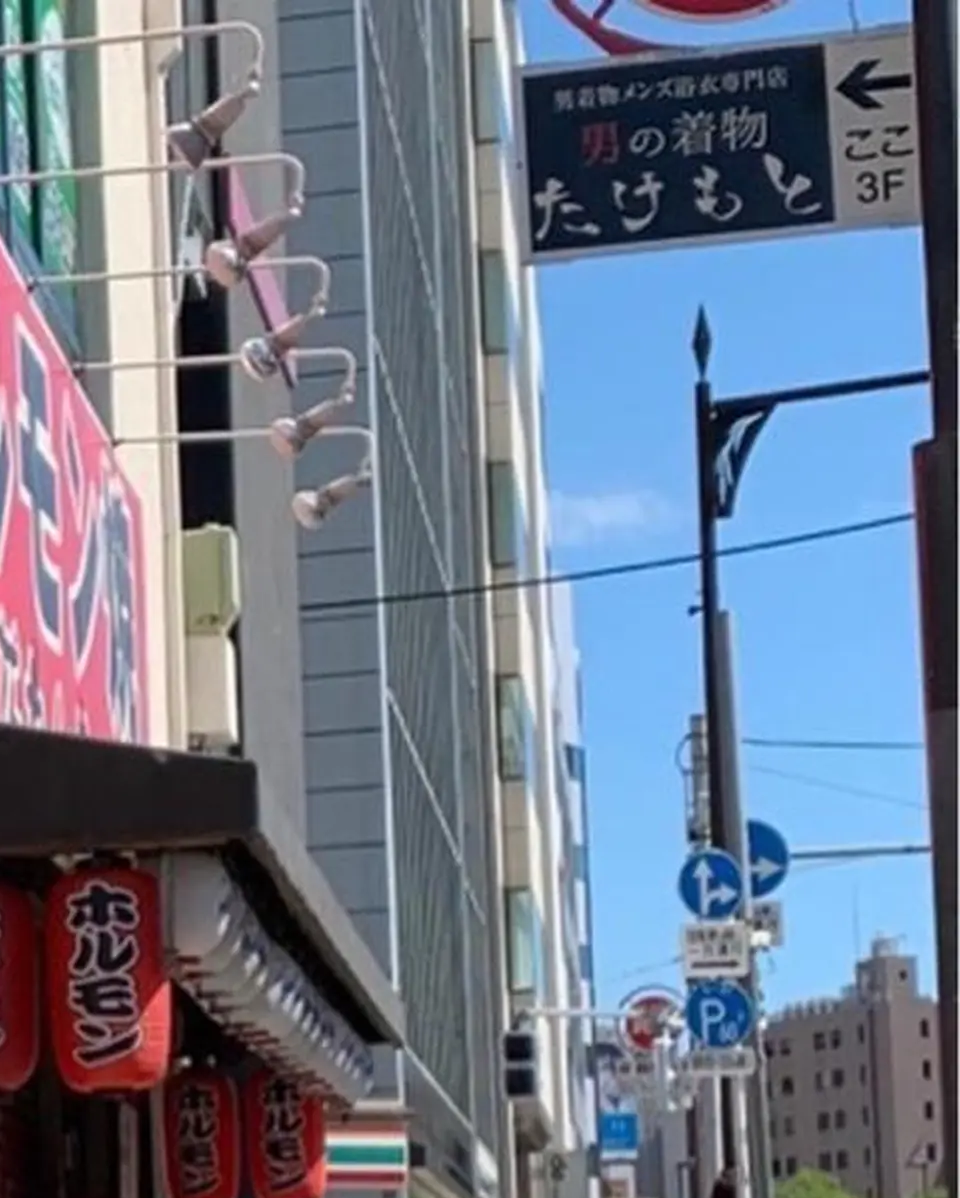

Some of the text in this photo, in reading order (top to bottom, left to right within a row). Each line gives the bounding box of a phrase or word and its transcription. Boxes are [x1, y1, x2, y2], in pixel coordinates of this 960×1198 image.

[581, 105, 769, 166] 男の着物
[845, 126, 915, 163] ここ
[533, 153, 823, 242] たけもと
[856, 169, 906, 205] 3F
[66, 879, 141, 1068] ホルモン
